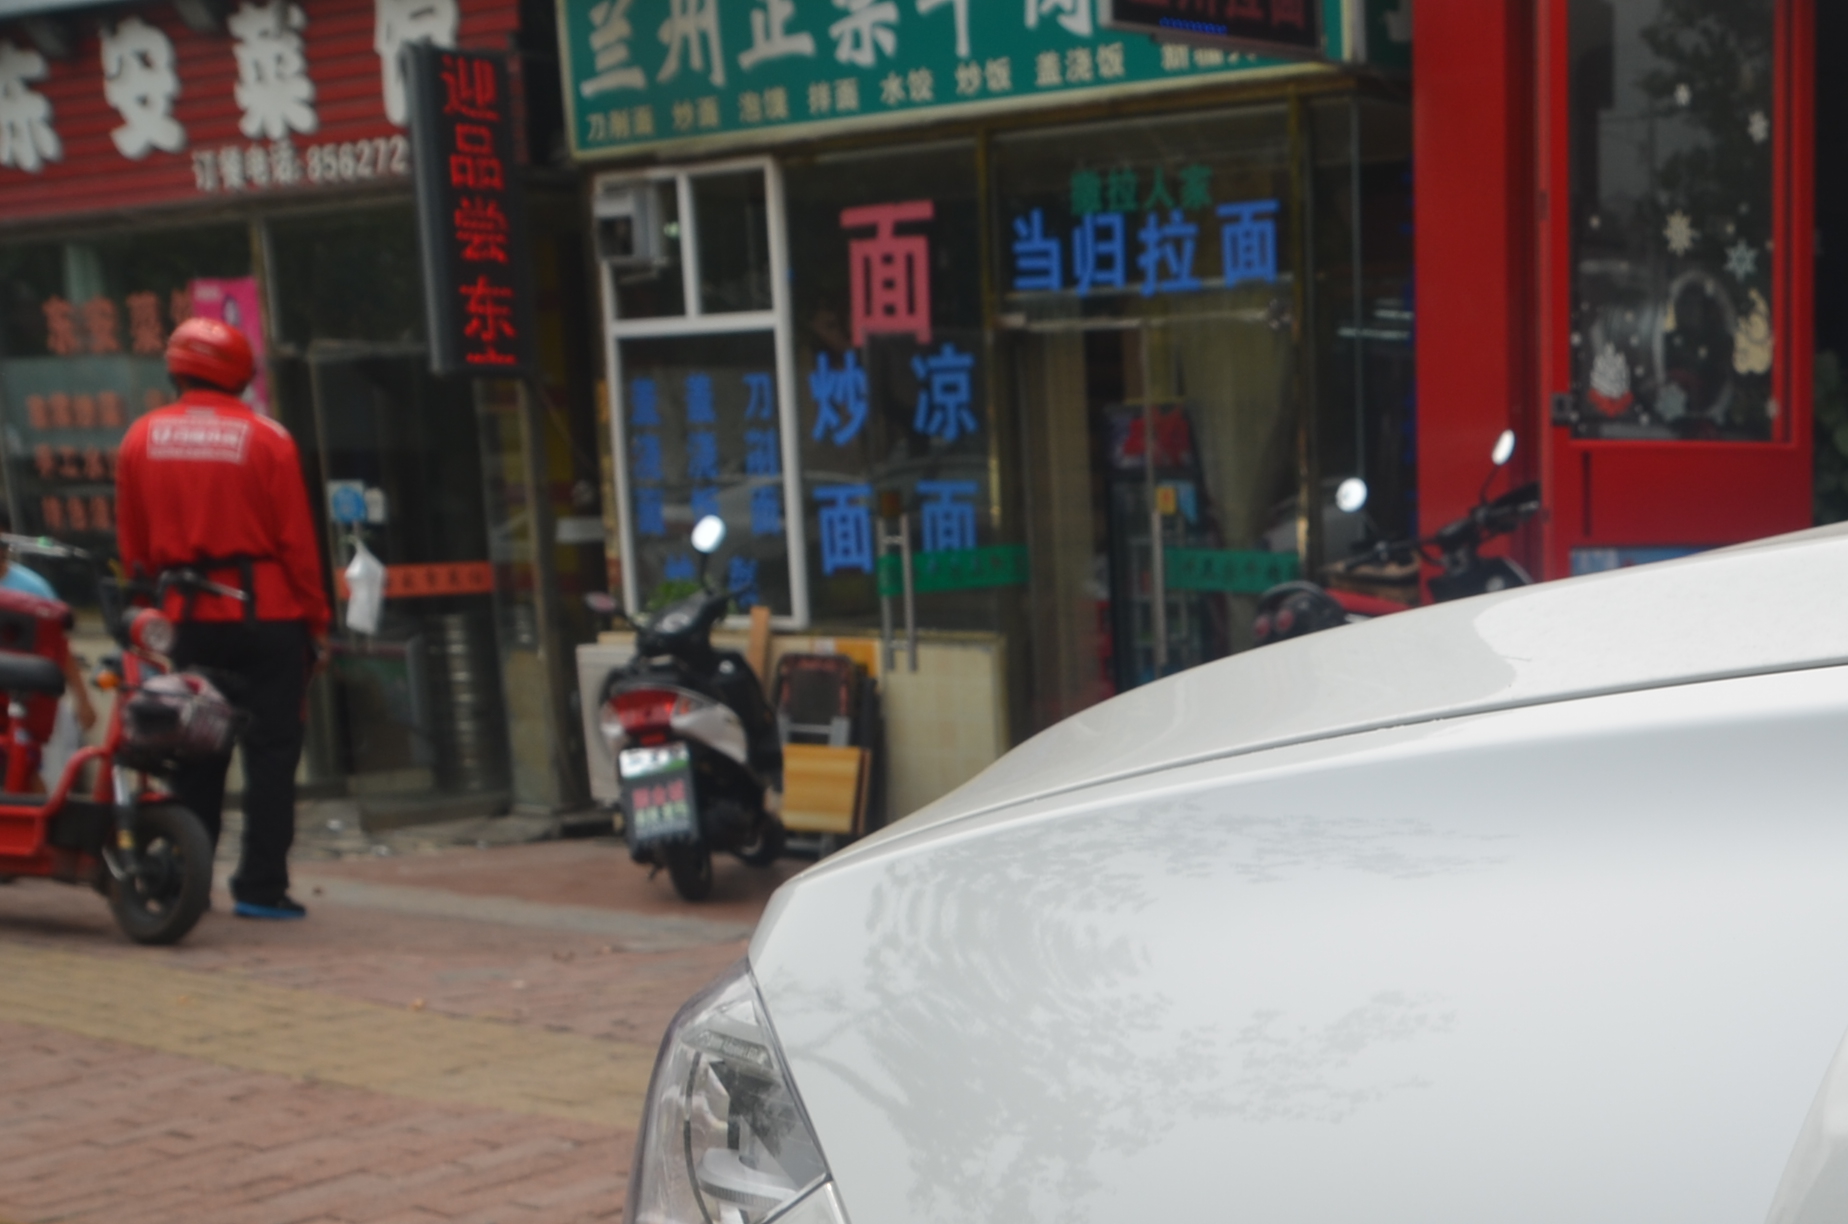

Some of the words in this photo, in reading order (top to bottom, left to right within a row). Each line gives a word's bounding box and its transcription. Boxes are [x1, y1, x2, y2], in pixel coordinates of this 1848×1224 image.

[880, 66, 934, 106] 水饺
[955, 57, 1012, 96] 炒饭
[1035, 42, 1125, 87] 盖浇饭
[440, 53, 517, 365] 迎品尝东
[1012, 198, 1280, 298] 当归拉面
[840, 199, 935, 347] 面
